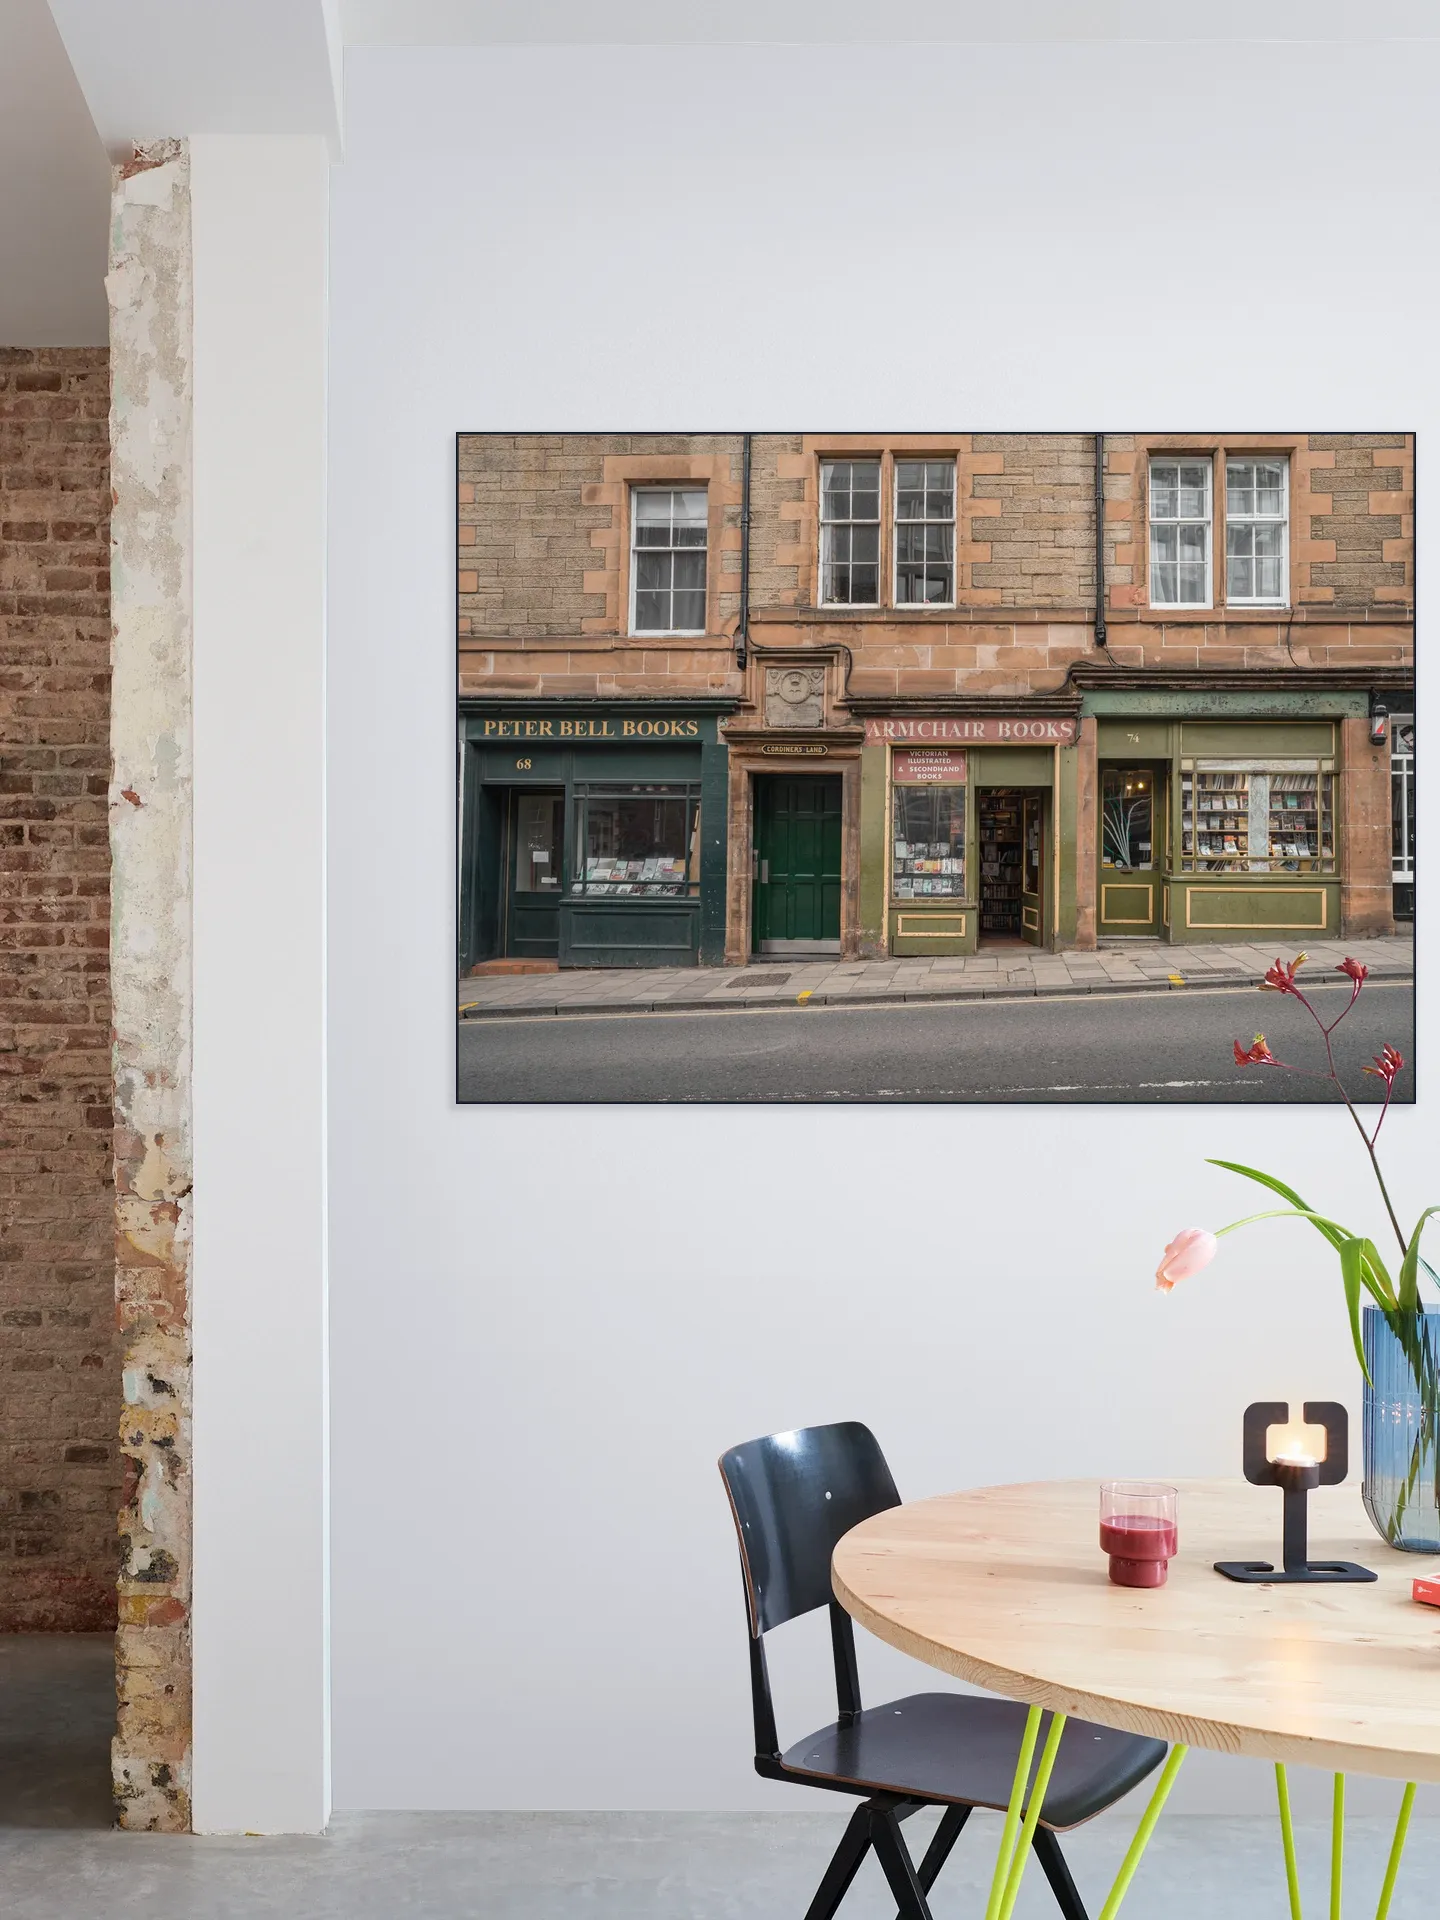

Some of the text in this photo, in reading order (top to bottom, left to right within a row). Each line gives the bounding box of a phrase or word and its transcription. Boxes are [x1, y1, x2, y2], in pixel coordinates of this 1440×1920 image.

[483, 720, 699, 736] PETER BELL BOOKS
[867, 721, 1073, 738] ARMCHAIR BOOKS
[1126, 732, 1140, 743] 74
[516, 758, 532, 770] 68
